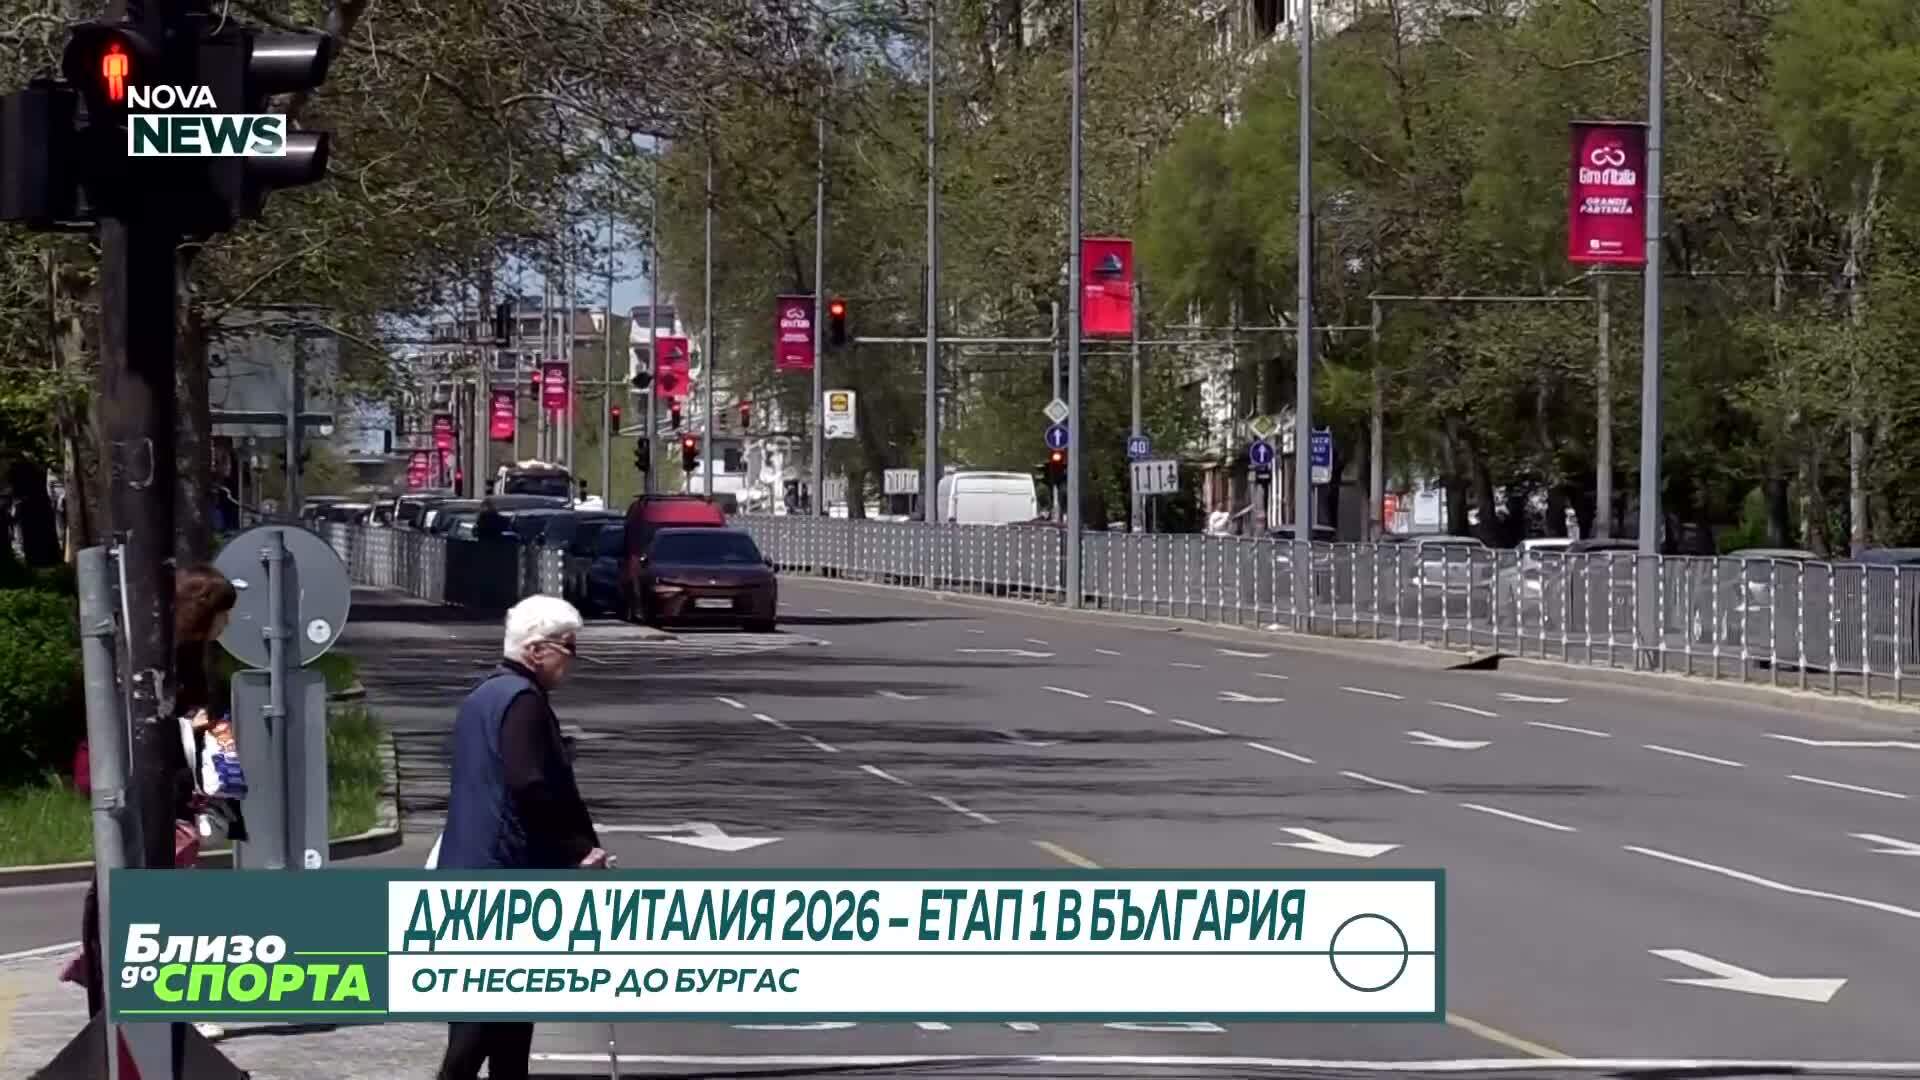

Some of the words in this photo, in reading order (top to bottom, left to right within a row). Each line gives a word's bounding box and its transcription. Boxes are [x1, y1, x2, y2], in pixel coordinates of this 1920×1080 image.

[1579, 167, 1601, 185] Giro
[1585, 197, 1629, 206] GRANDE
[1130, 441, 1146, 454] 40
